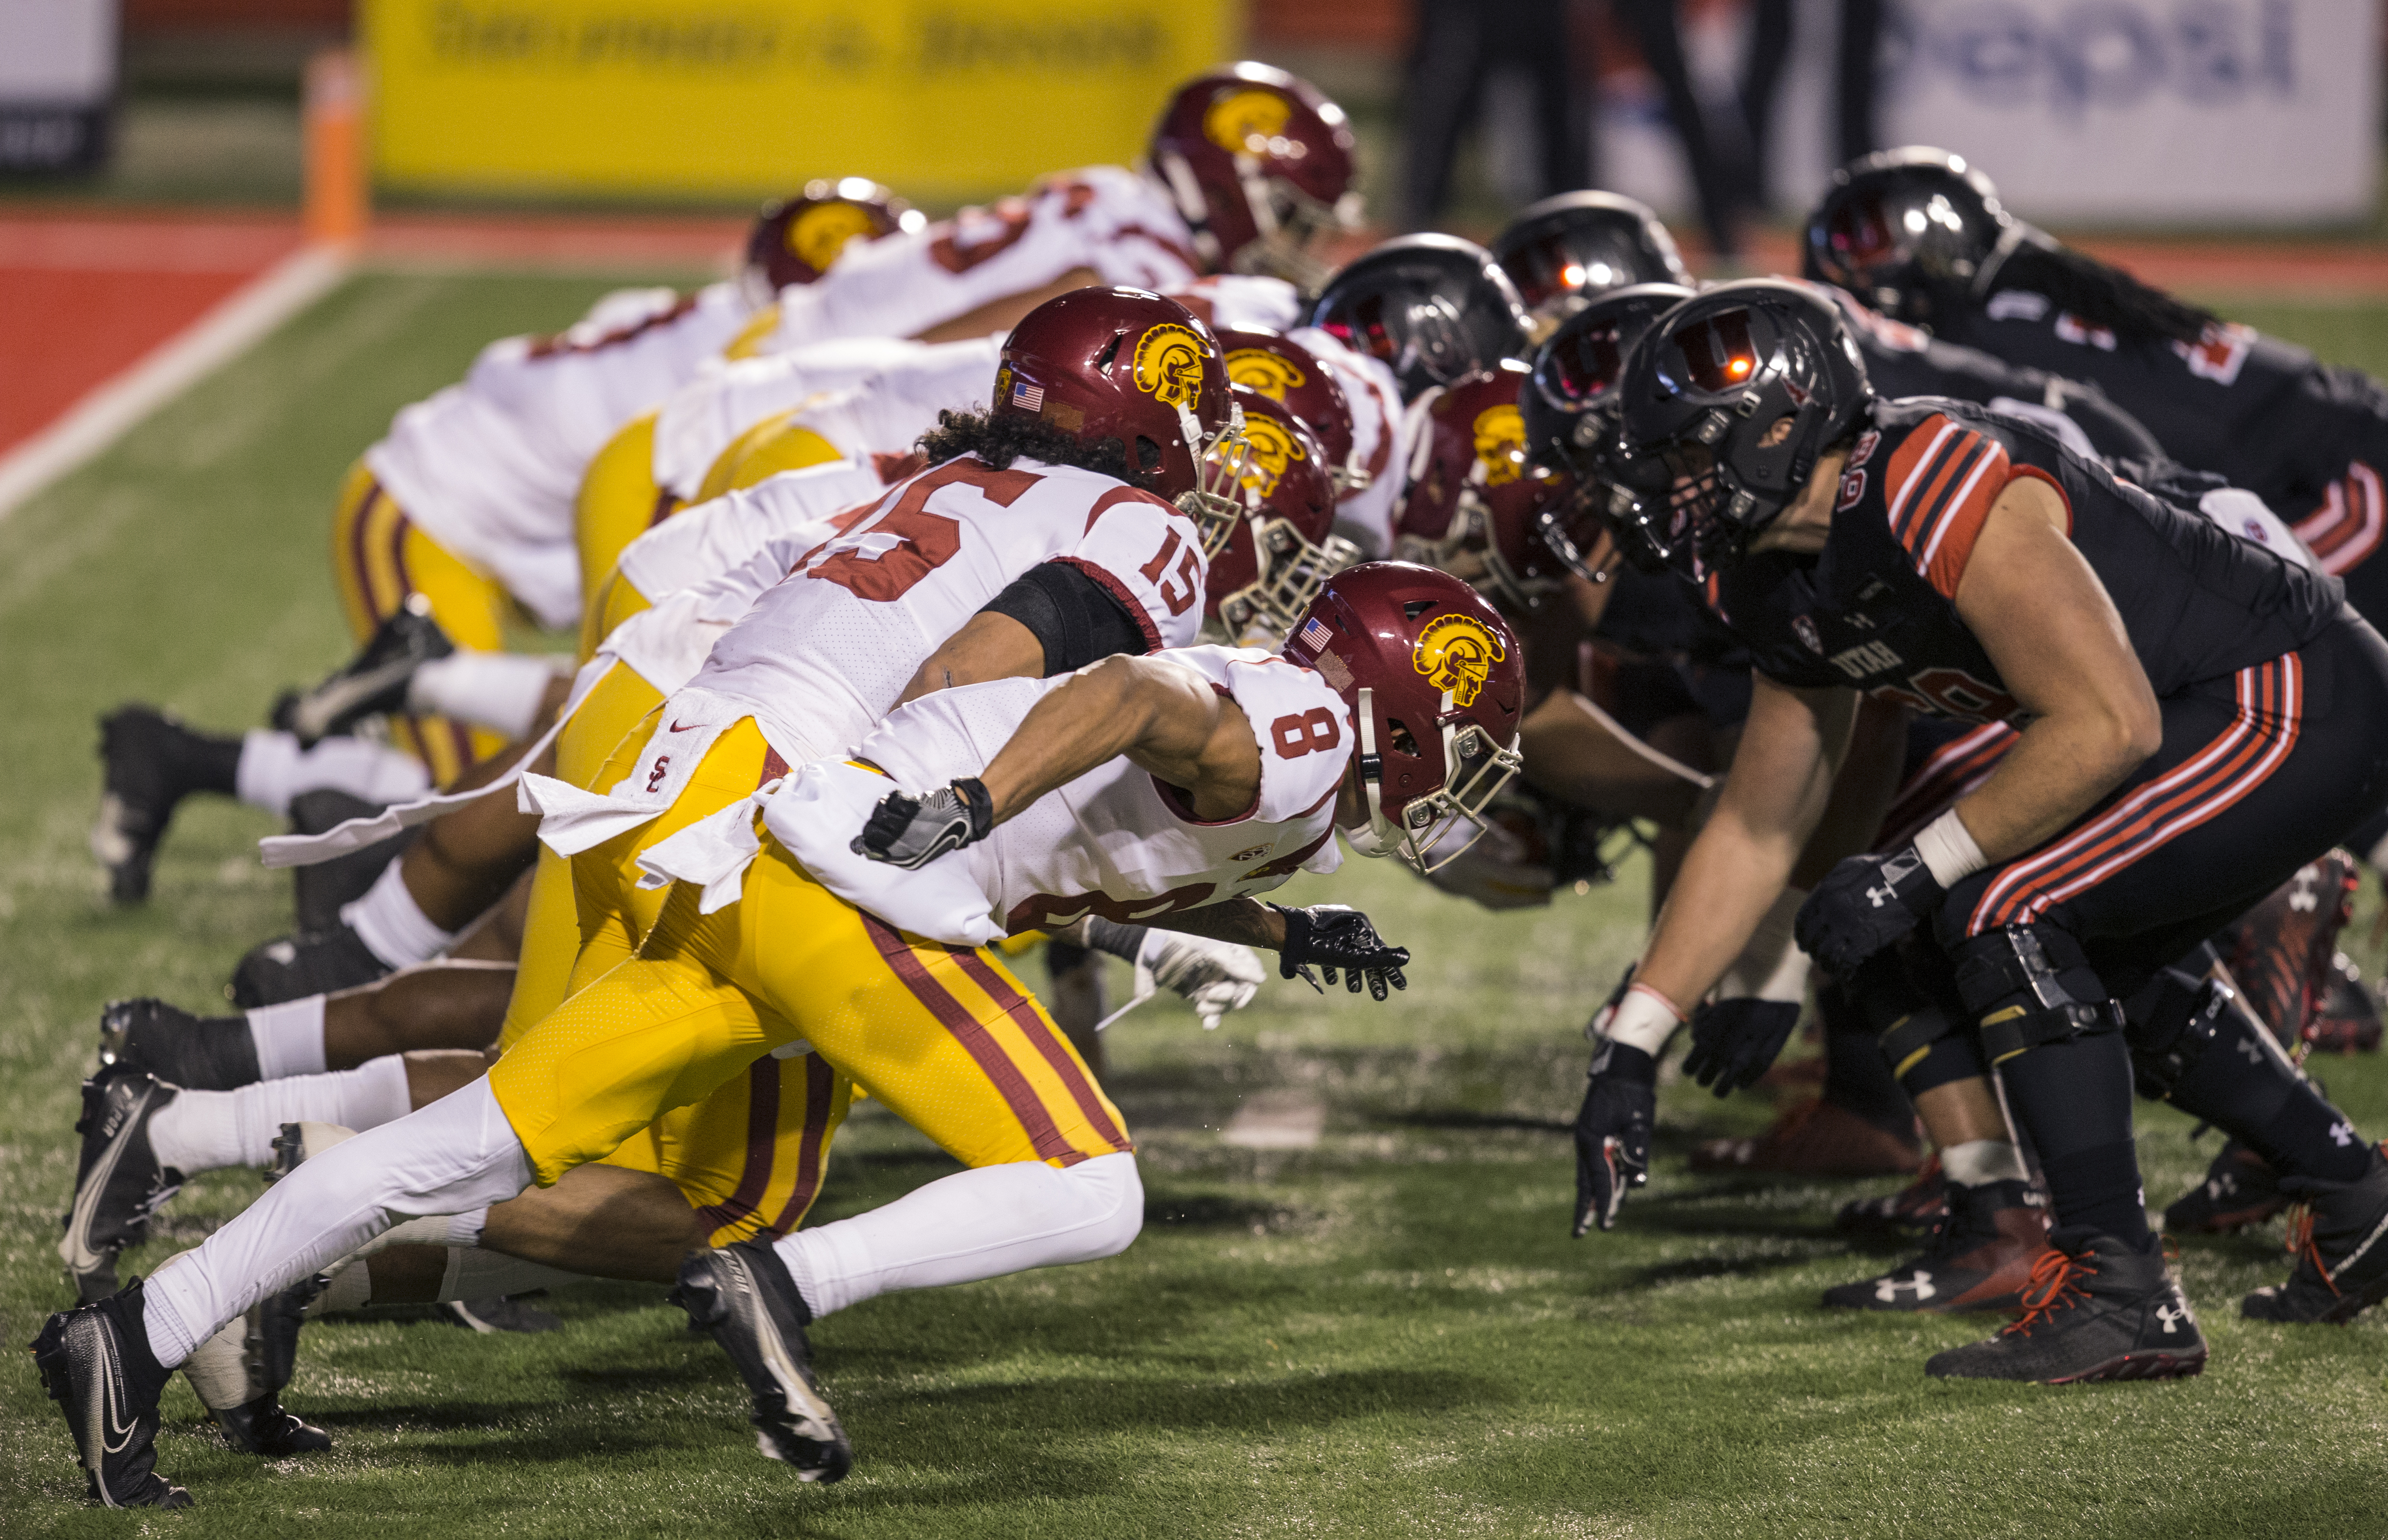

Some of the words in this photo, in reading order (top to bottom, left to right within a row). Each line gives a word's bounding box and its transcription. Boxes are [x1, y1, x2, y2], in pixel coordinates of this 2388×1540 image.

[1139, 524, 1201, 617] 15
[1828, 640, 1903, 679] UTAH
[1270, 707, 1340, 760] 8
